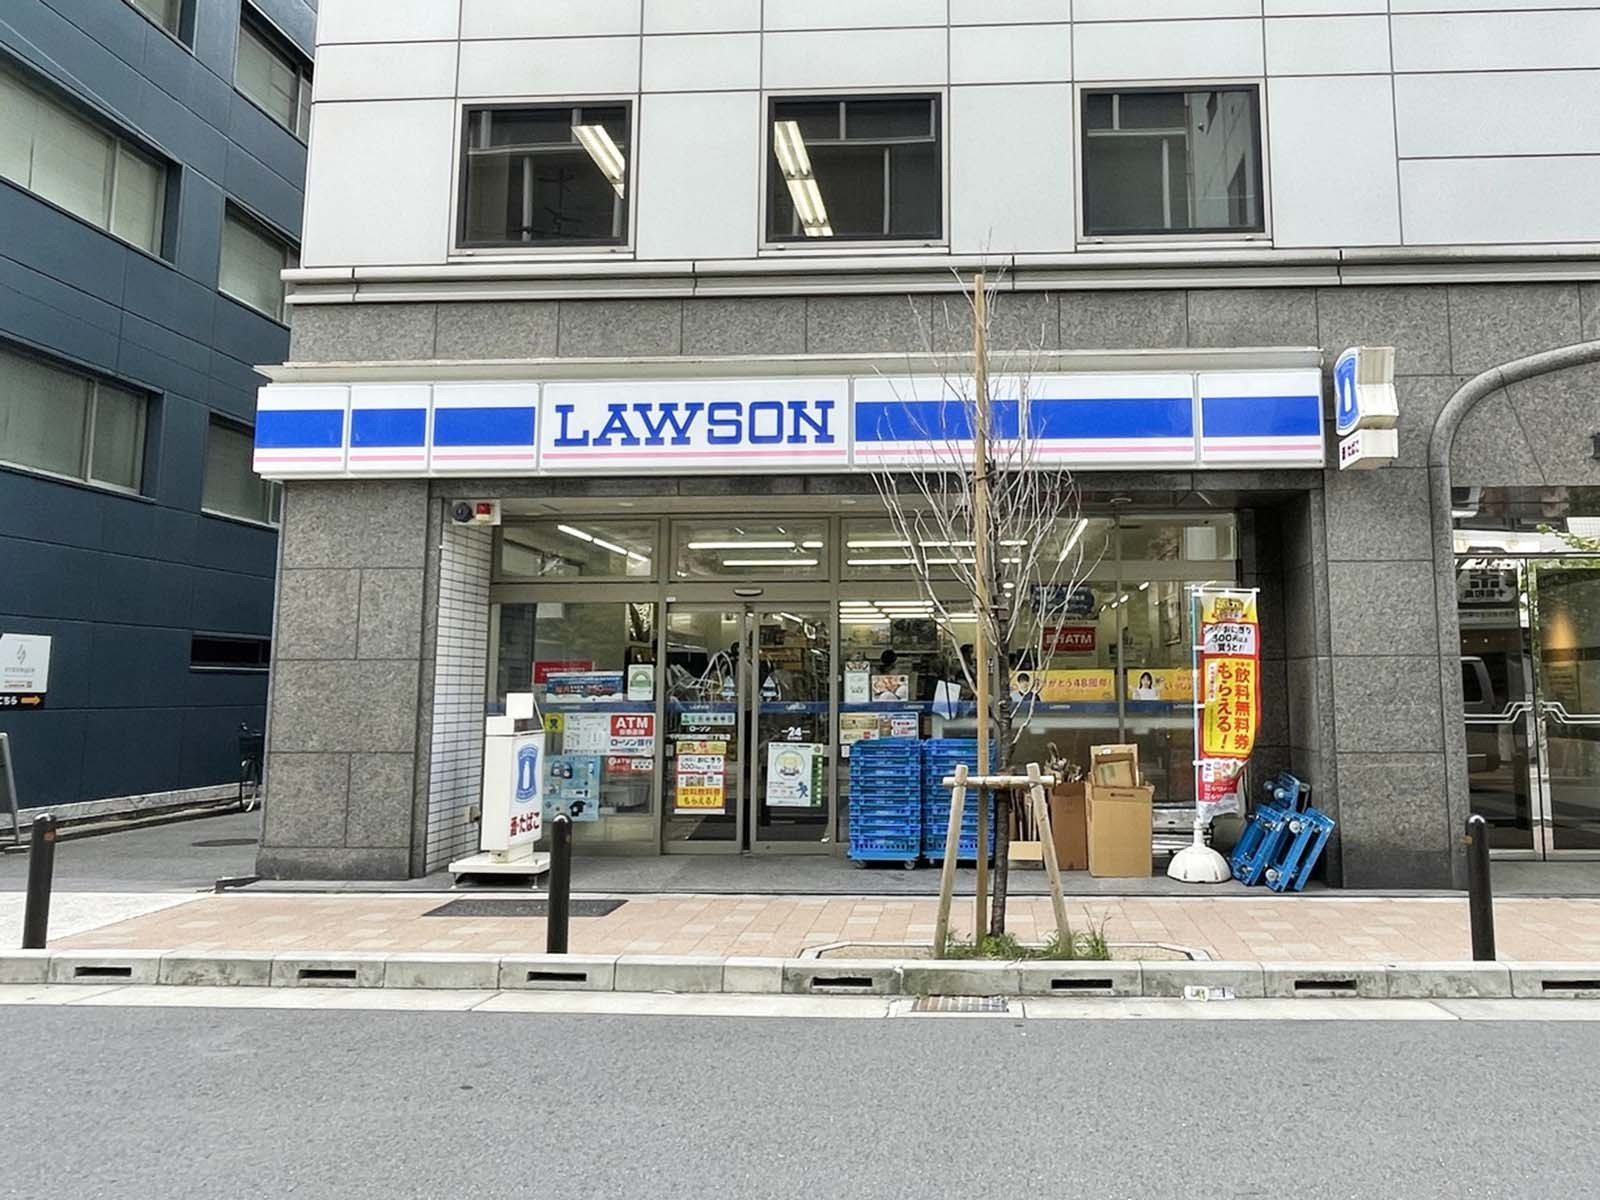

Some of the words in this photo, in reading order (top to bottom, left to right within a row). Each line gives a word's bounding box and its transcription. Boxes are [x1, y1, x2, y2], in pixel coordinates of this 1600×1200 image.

[554, 400, 835, 447] LAWSON
[616, 717, 648, 729] ATM
[1217, 661, 1232, 749] もらえる!
[1234, 667, 1250, 750] 飲料無料券
[788, 726, 802, 737] 24
